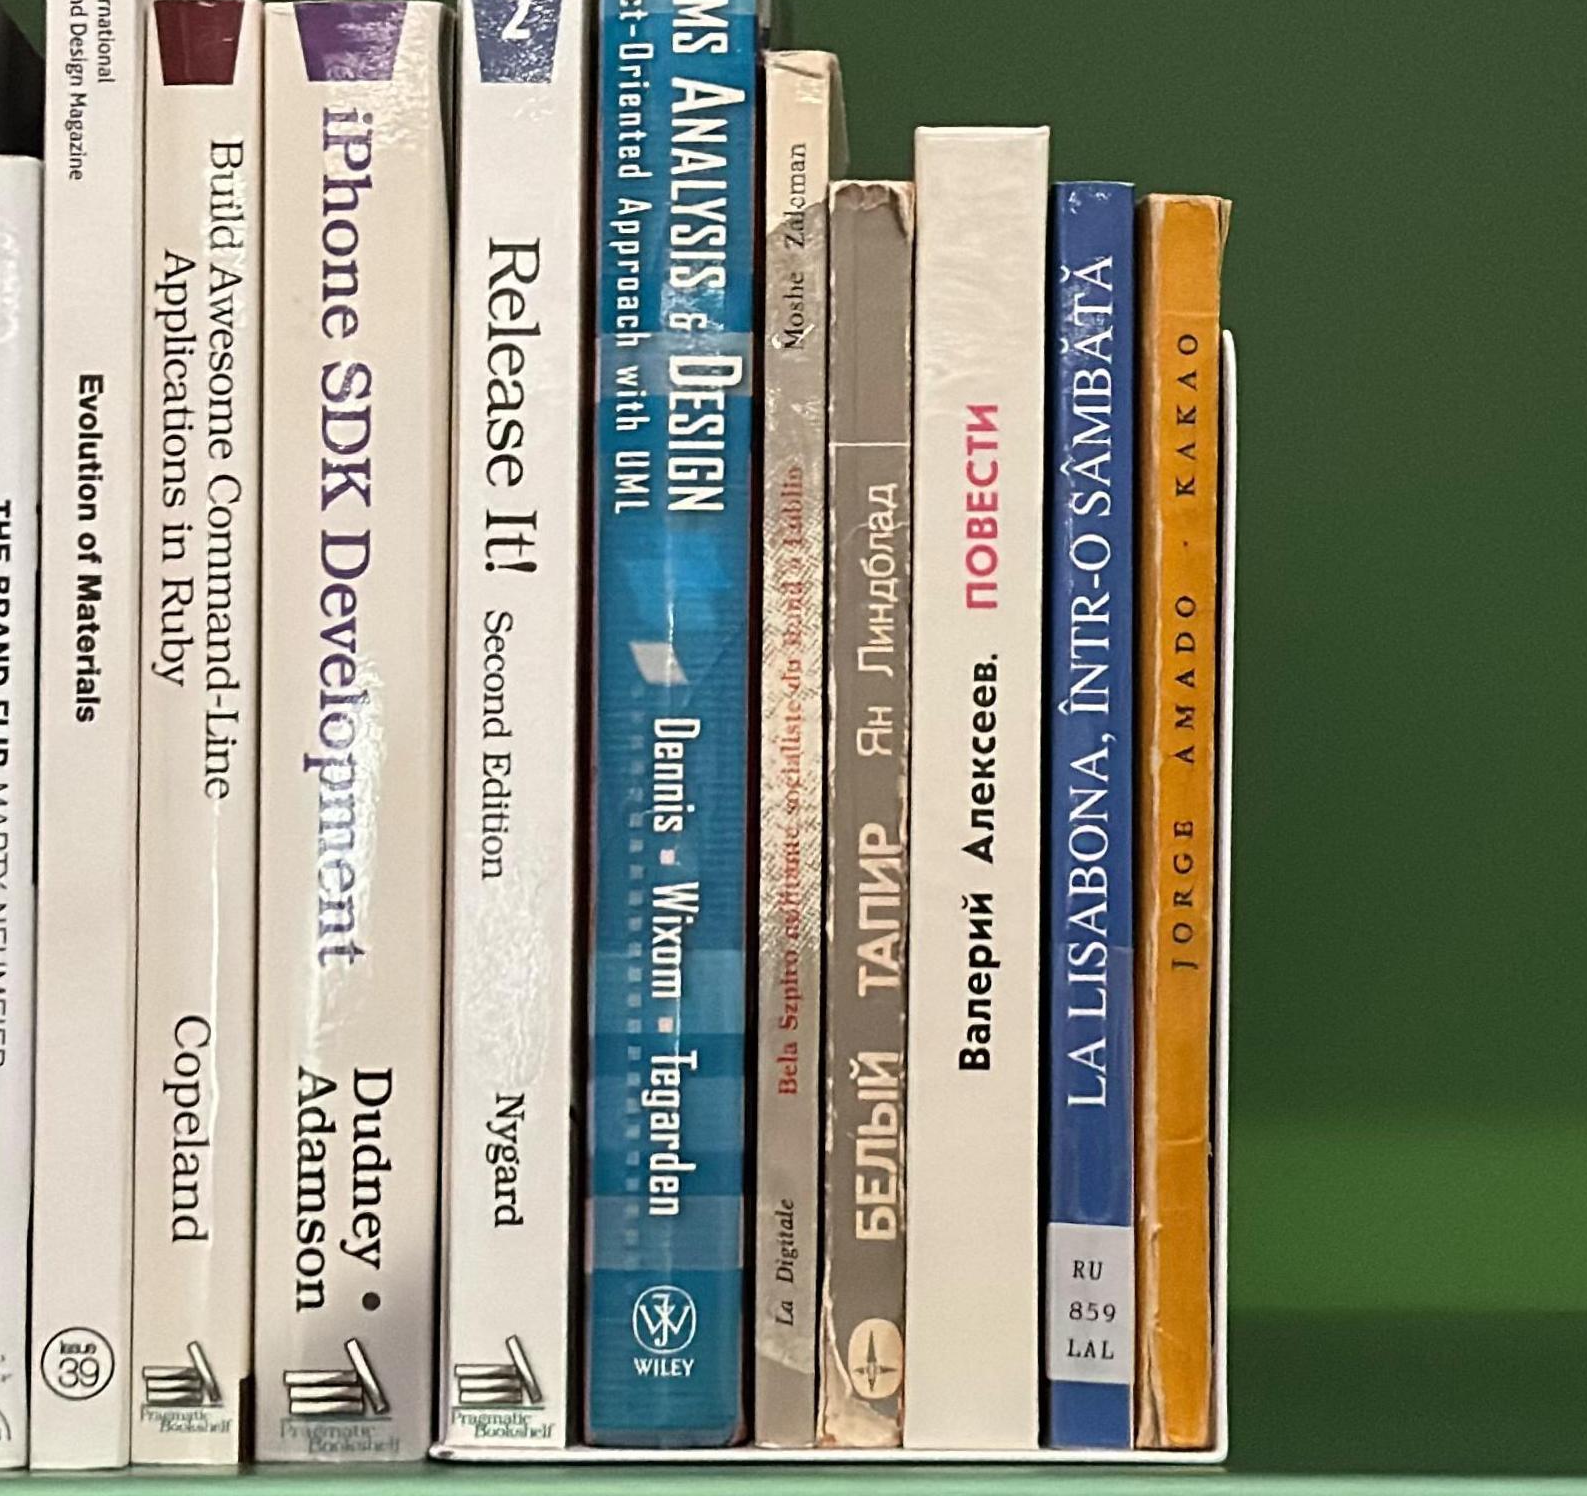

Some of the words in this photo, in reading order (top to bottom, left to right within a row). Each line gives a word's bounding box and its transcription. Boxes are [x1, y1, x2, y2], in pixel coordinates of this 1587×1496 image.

[66, 23, 88, 87] Design
[65, 92, 86, 181] Magazine
[209, 140, 245, 250] Build
[322, 106, 375, 340] iPhone
[609, 198, 653, 347] Approach
[155, 248, 197, 508] Applications
[208, 263, 243, 459] Awesome
[485, 236, 542, 488] Release
[782, 271, 806, 351] Moshe
[76, 373, 104, 522] Evolution
[320, 360, 372, 512] SDK
[615, 365, 651, 431] with
[1059, 256, 1114, 518] SÂMBĂTĂ
[1175, 333, 1199, 498] KAKAO
[76, 531, 102, 563] of
[162, 521, 194, 562] in
[485, 508, 538, 574] It!
[613, 451, 651, 515] UML
[965, 403, 999, 611] ПОВЕСТИ
[75, 573, 102, 723] Materials
[152, 577, 195, 688] Ruby
[204, 473, 242, 799] Command-Line
[856, 482, 898, 678] Линдблад
[1057, 533, 1113, 716] ÎNTR-O
[302, 529, 371, 968] Development
[483, 610, 514, 740] Second
[856, 706, 893, 757] Ян
[1173, 595, 1197, 765] AMADO
[481, 751, 512, 881] Edition
[653, 717, 701, 833] Dennis
[960, 653, 998, 865] Алексеев.
[651, 881, 700, 999] Wixom
[856, 821, 901, 999] ТАПИР
[1067, 732, 1116, 1020] LISABONA,
[1171, 820, 1199, 971] JORGE
[957, 893, 1001, 1072] Валерий
[162, 1014, 212, 1243] Copeland
[640, 1049, 698, 1216] Tegarden
[776, 1041, 799, 1095] Bela
[1067, 1036, 1108, 1108] LA
[295, 1065, 338, 1313] Adamson
[340, 1067, 393, 1270] Dudney
[485, 1092, 526, 1228] Nygard
[849, 1051, 900, 1241] БЕЛЫЙ
[774, 1197, 799, 1284] Digitale
[775, 1300, 794, 1327] La
[1068, 1301, 1117, 1323] 859
[1072, 1259, 1104, 1281] RU
[58, 1357, 100, 1388] 39
[633, 1357, 695, 1379] WILEY
[1066, 1338, 1115, 1361] LAL
